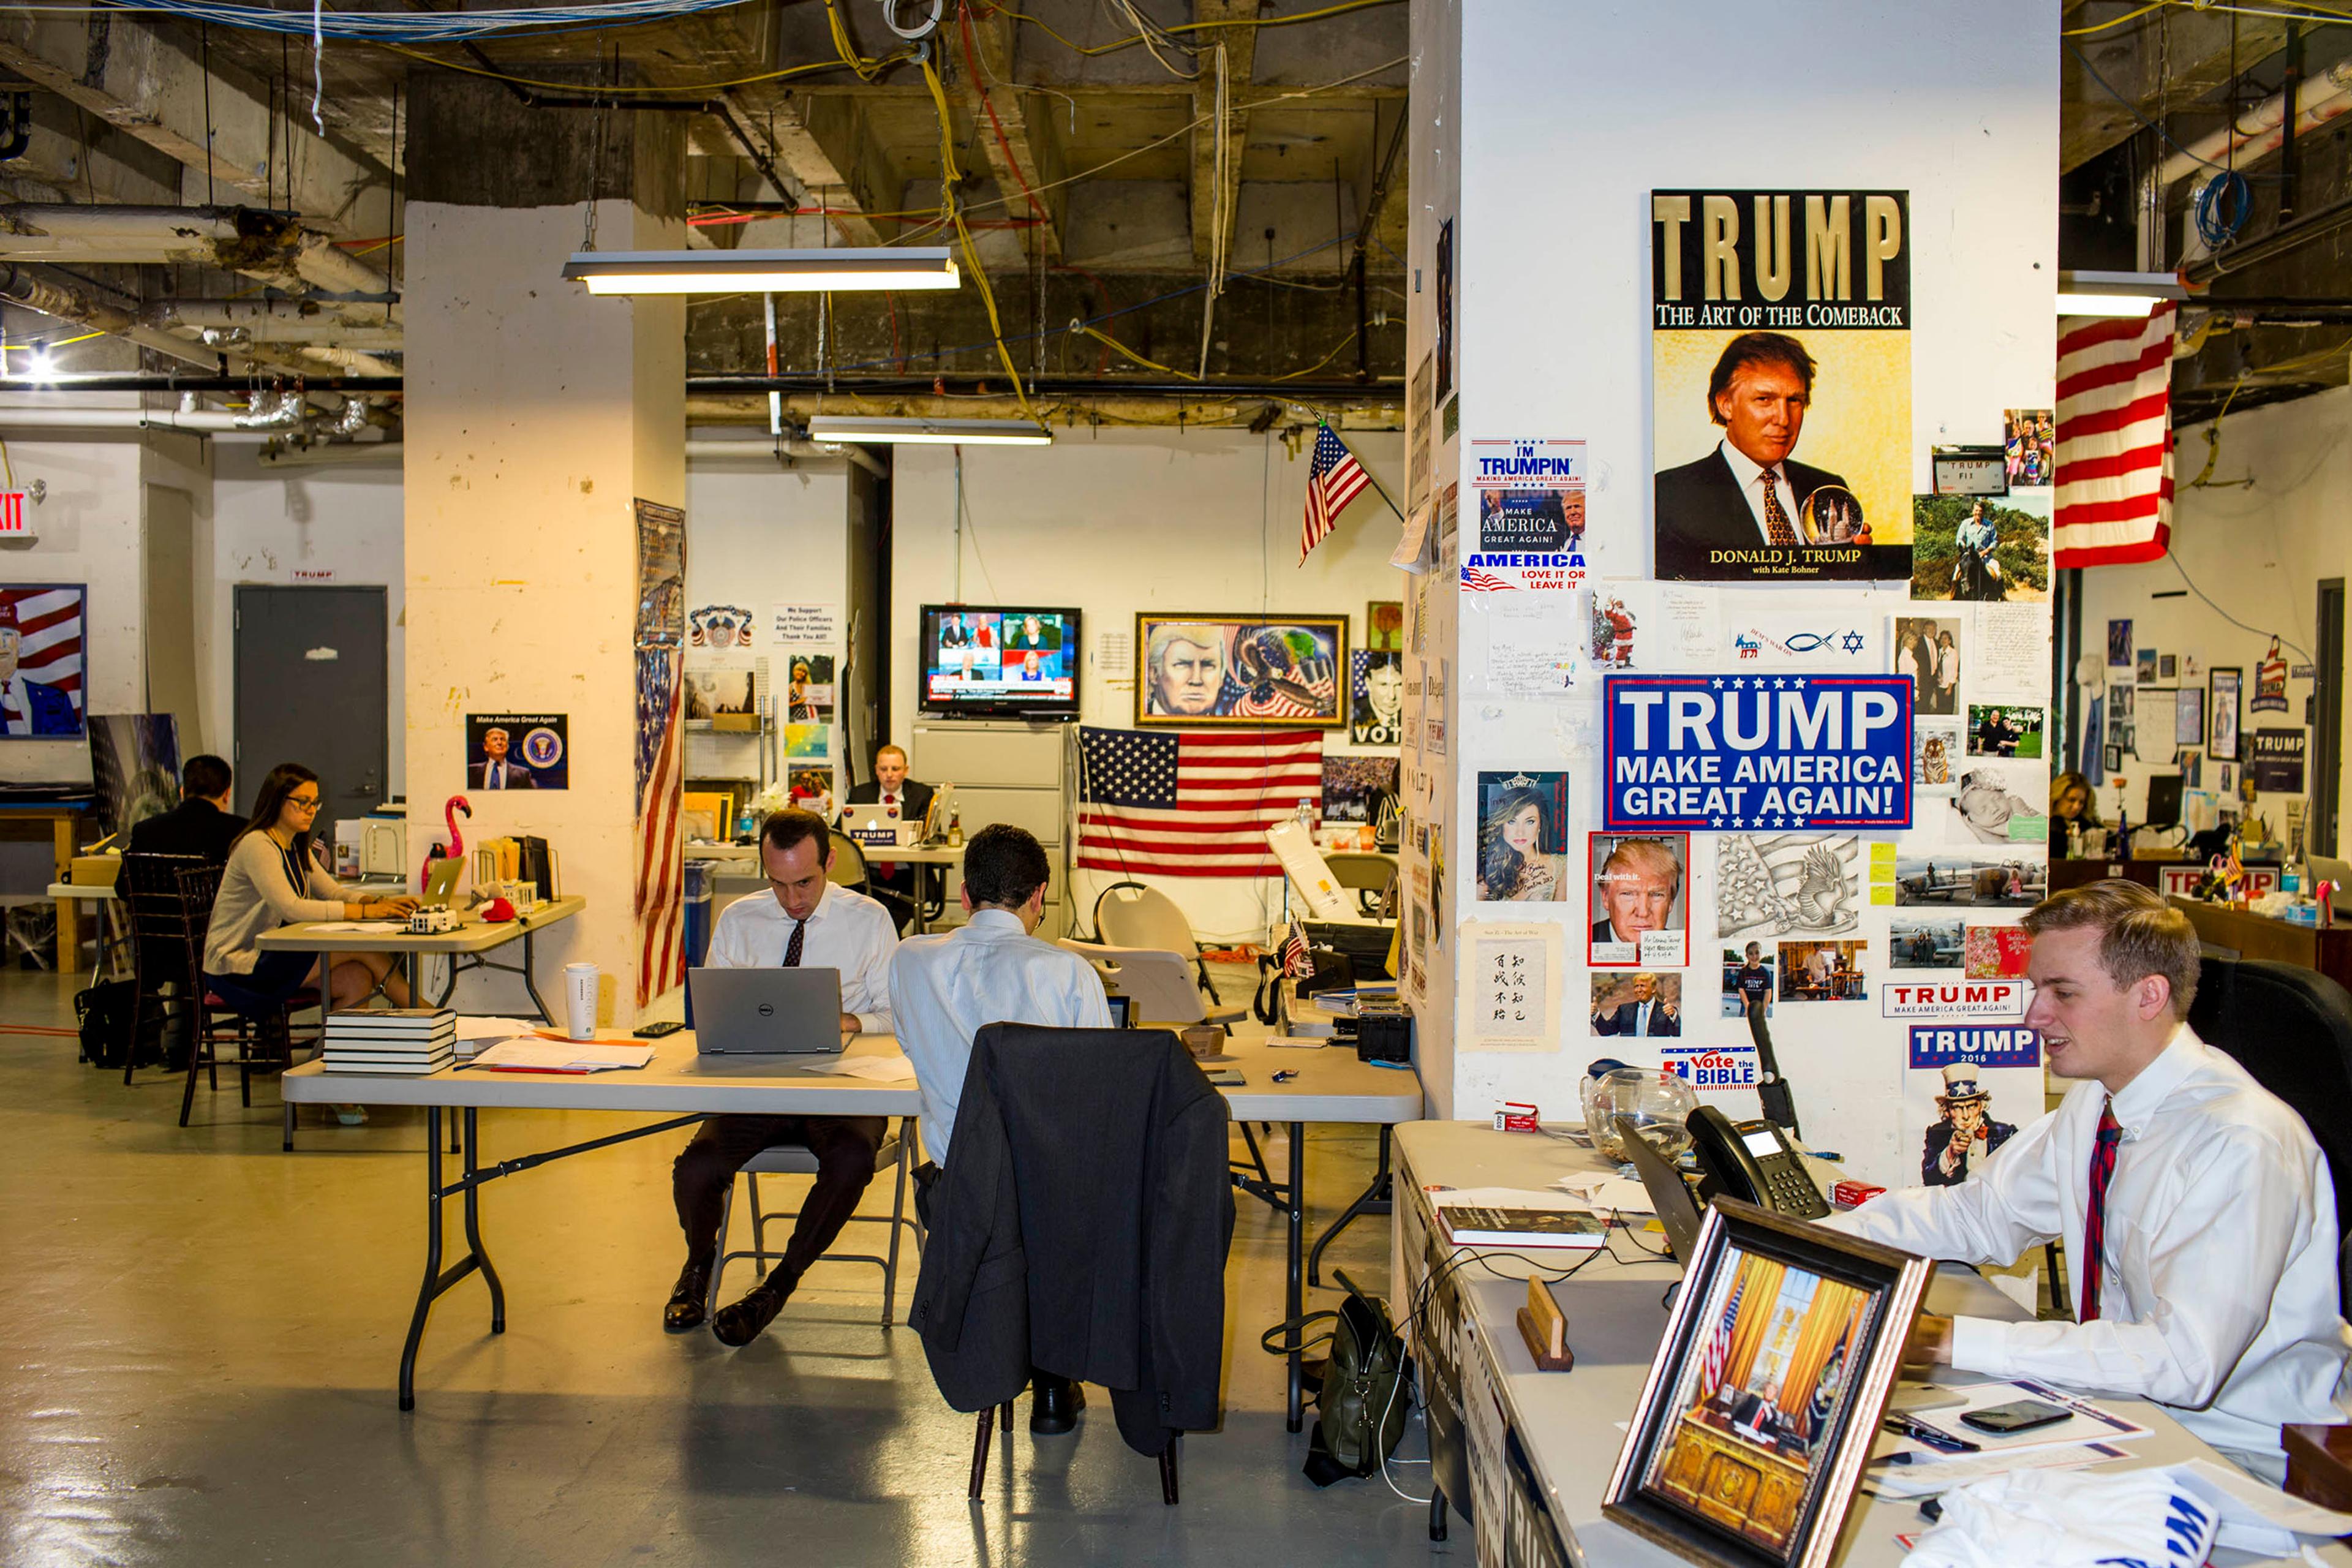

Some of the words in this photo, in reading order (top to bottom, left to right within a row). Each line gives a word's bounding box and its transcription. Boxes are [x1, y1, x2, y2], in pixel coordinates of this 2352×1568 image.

[1653, 195, 1901, 302] TRUMP
[1740, 306, 1763, 326] OF
[1517, 446, 1534, 458] I'M
[1479, 458, 1574, 475] TRUMPIN'
[0, 493, 24, 530] IT
[1481, 519, 1558, 532] AMERICA
[1468, 554, 1586, 567] AMERICA
[1711, 550, 1783, 563] DONALD
[1785, 550, 1796, 565] J.
[1802, 549, 1861, 562] TRUMP
[1619, 691, 1898, 751] TRUMP
[2256, 736, 2304, 752] TRUMP
[1616, 756, 1721, 783] MAKE
[1733, 755, 1903, 783] AMERICA
[1623, 786, 1747, 815] GREAT
[1760, 786, 1893, 815] AGAIN!
[2166, 873, 2273, 893] TRMP
[1895, 986, 2011, 1004] TRUMP
[1915, 1030, 2034, 1052] TRUMP
[1690, 1049, 1734, 1068] Vote
[1961, 1054, 1987, 1063] 2016
[1696, 1068, 1754, 1084] BIBLE
[1428, 1274, 1461, 1373] RUMP
